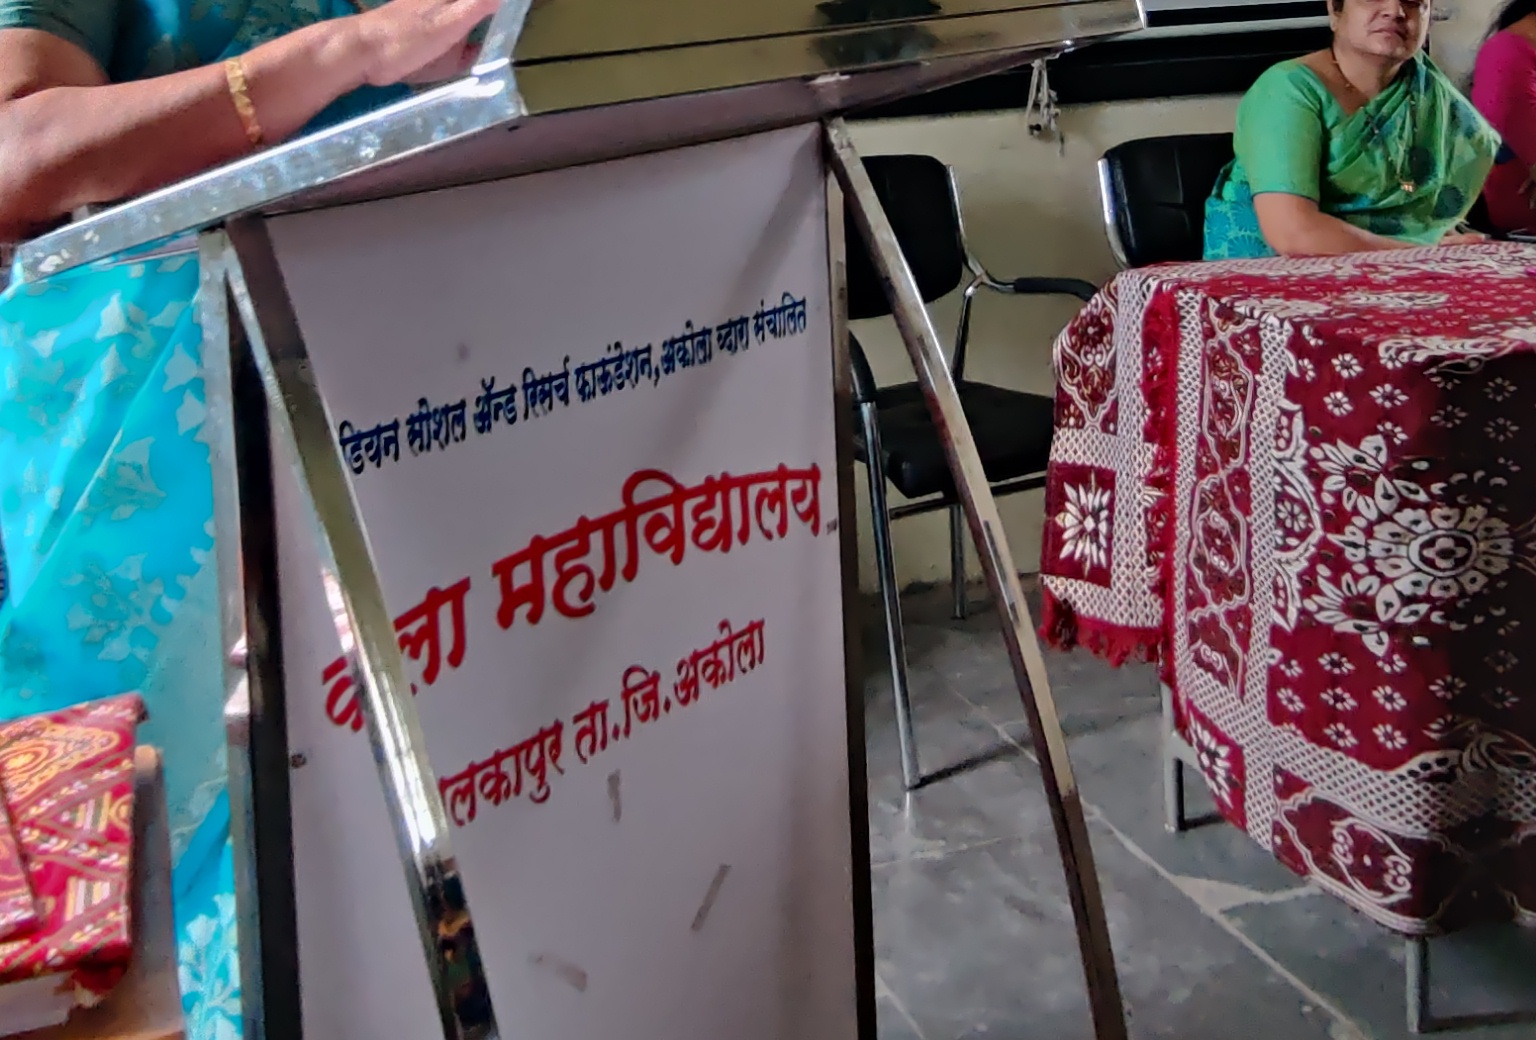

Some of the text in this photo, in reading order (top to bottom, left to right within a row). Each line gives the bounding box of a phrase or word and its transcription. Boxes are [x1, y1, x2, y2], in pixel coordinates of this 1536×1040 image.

[339, 420, 400, 475] डियन
[522, 355, 570, 421] रिसर्च
[753, 291, 807, 347] संचालित
[491, 462, 821, 630] महाविद्यालय
[438, 719, 565, 827] लकापुर
